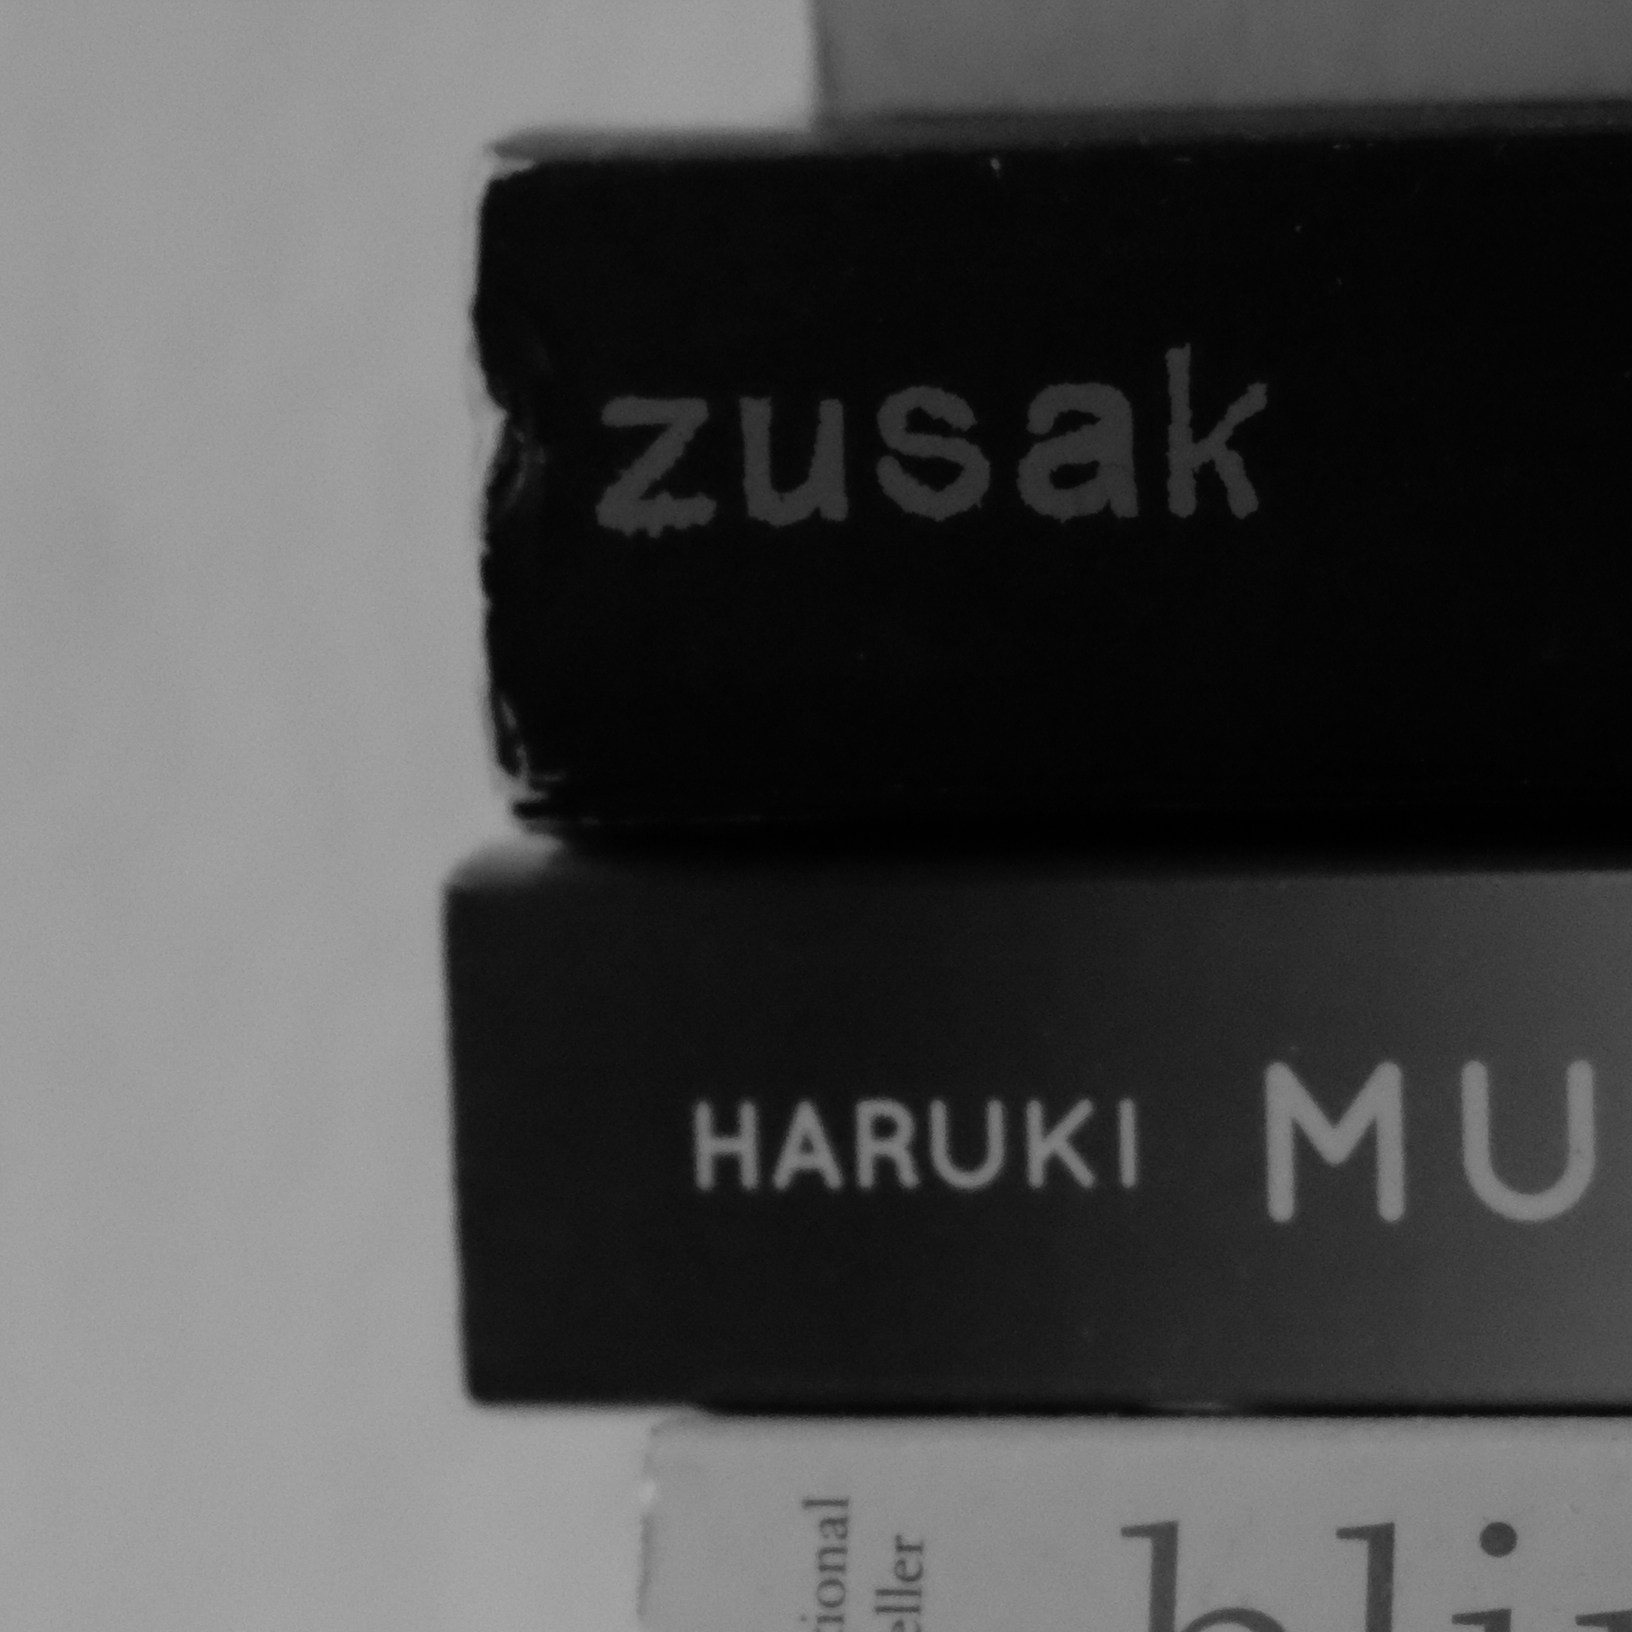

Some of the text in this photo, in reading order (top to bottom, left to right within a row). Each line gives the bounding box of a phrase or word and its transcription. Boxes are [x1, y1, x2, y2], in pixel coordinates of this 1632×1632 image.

[595, 343, 1269, 536] zusak
[694, 1061, 1598, 1221] HARUKI MU
